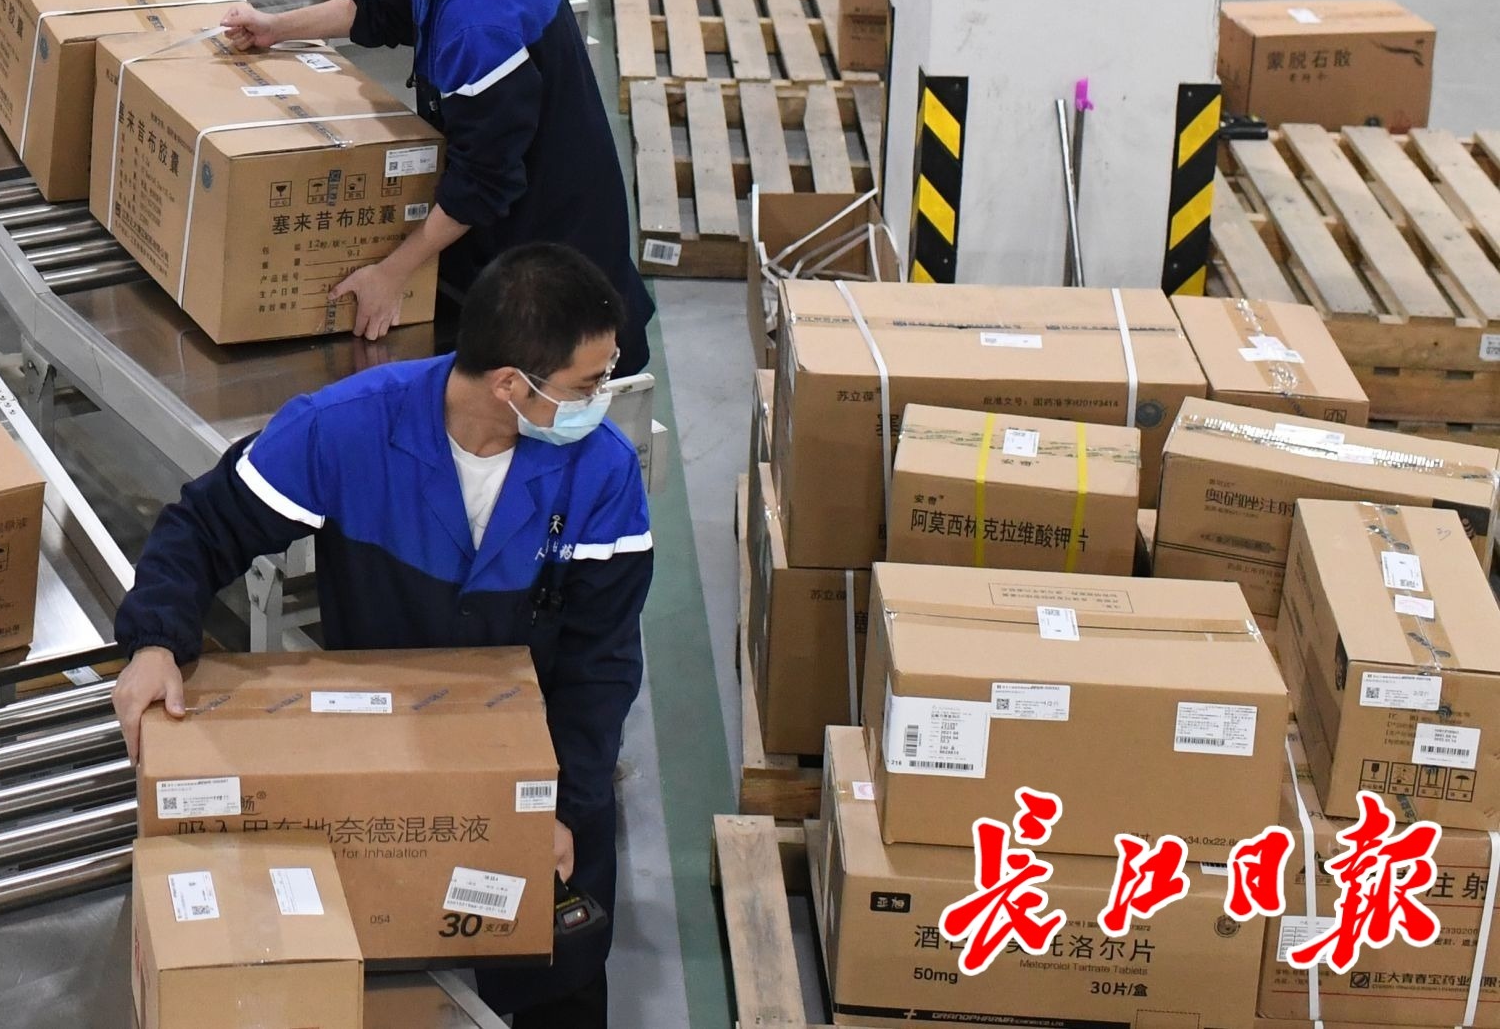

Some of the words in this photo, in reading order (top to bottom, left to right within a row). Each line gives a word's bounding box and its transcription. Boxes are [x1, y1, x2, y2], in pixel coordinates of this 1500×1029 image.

[272, 205, 397, 235] 塞来昔布胶囊
[910, 508, 1089, 552] 阿莫西林克拉维酸钾片
[342, 848, 359, 859] for
[364, 847, 428, 860] Inhalation
[913, 966, 959, 985] 50mg
[1114, 965, 1148, 976] Tablets
[1090, 981, 1148, 997] 30片/盒
